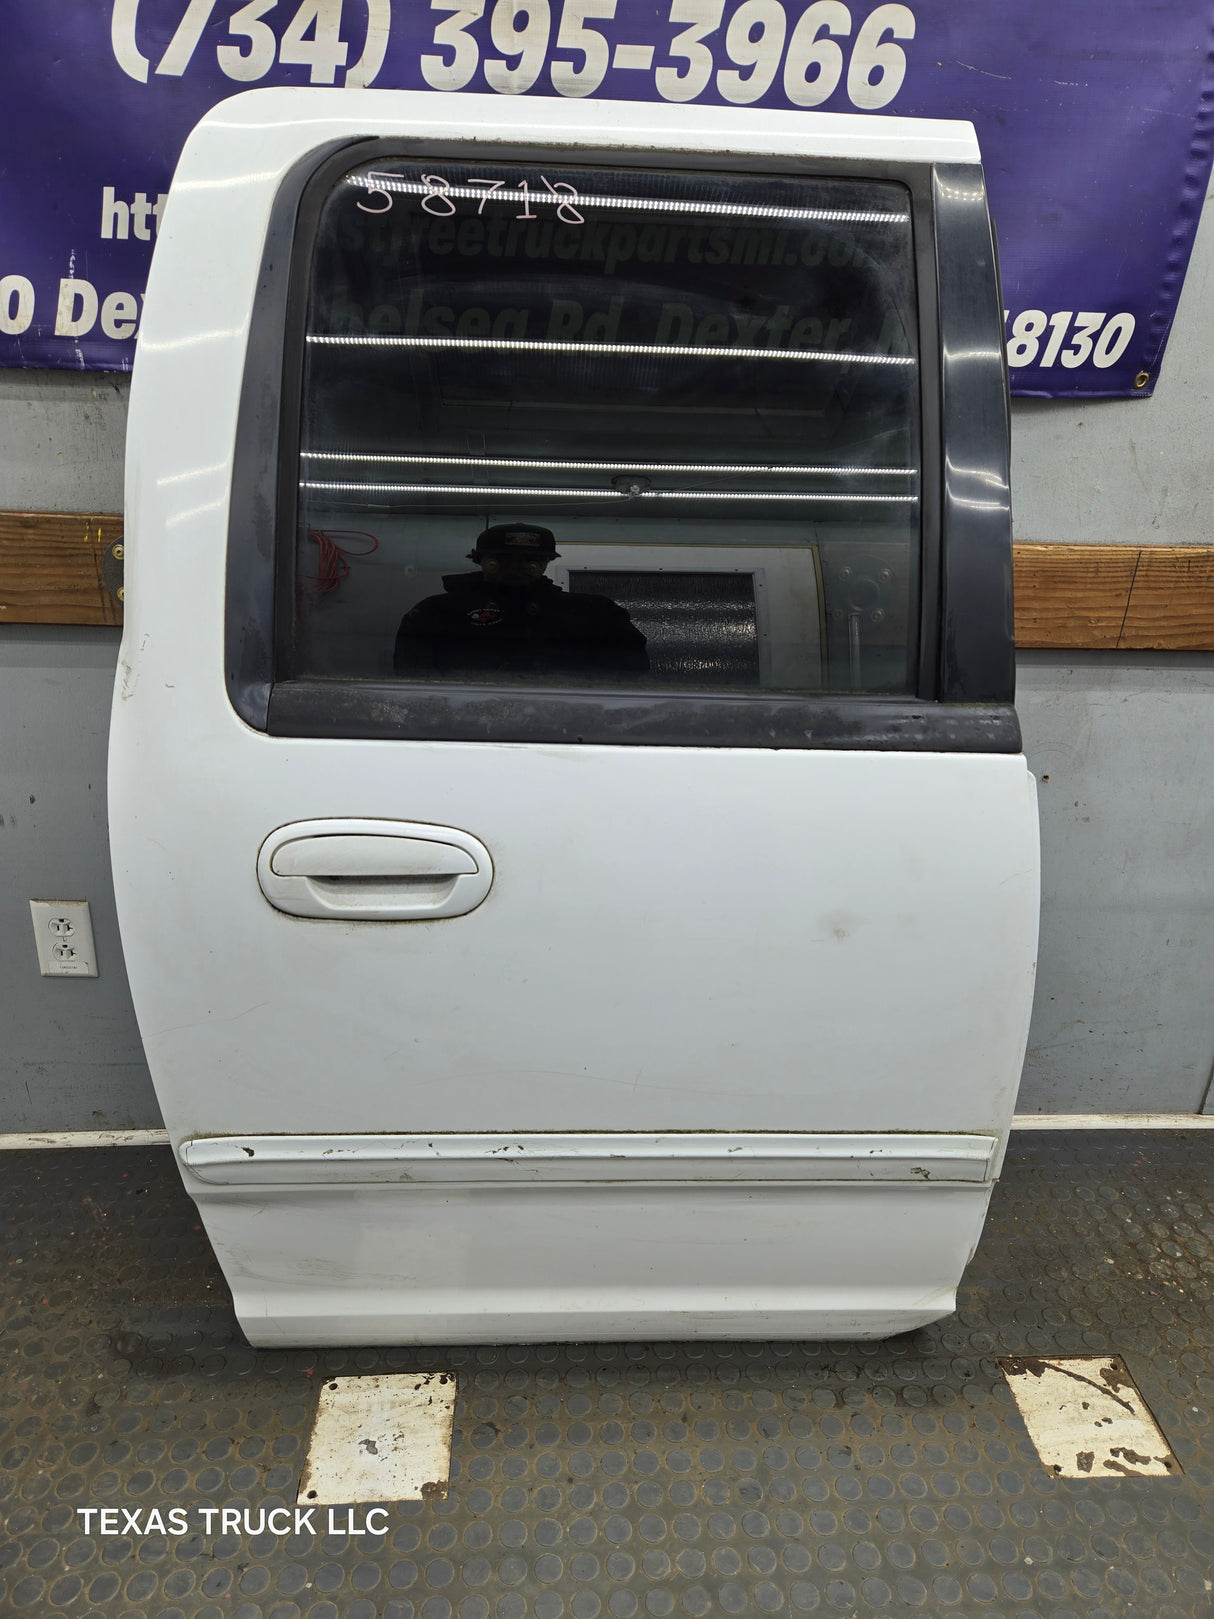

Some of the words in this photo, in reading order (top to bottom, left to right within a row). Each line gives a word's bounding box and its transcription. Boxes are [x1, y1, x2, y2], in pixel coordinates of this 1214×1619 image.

[420, 0, 916, 109] 395-3966
[356, 171, 585, 224] 58718
[54, 278, 146, 340] De
[1003, 309, 1136, 369] 8130
